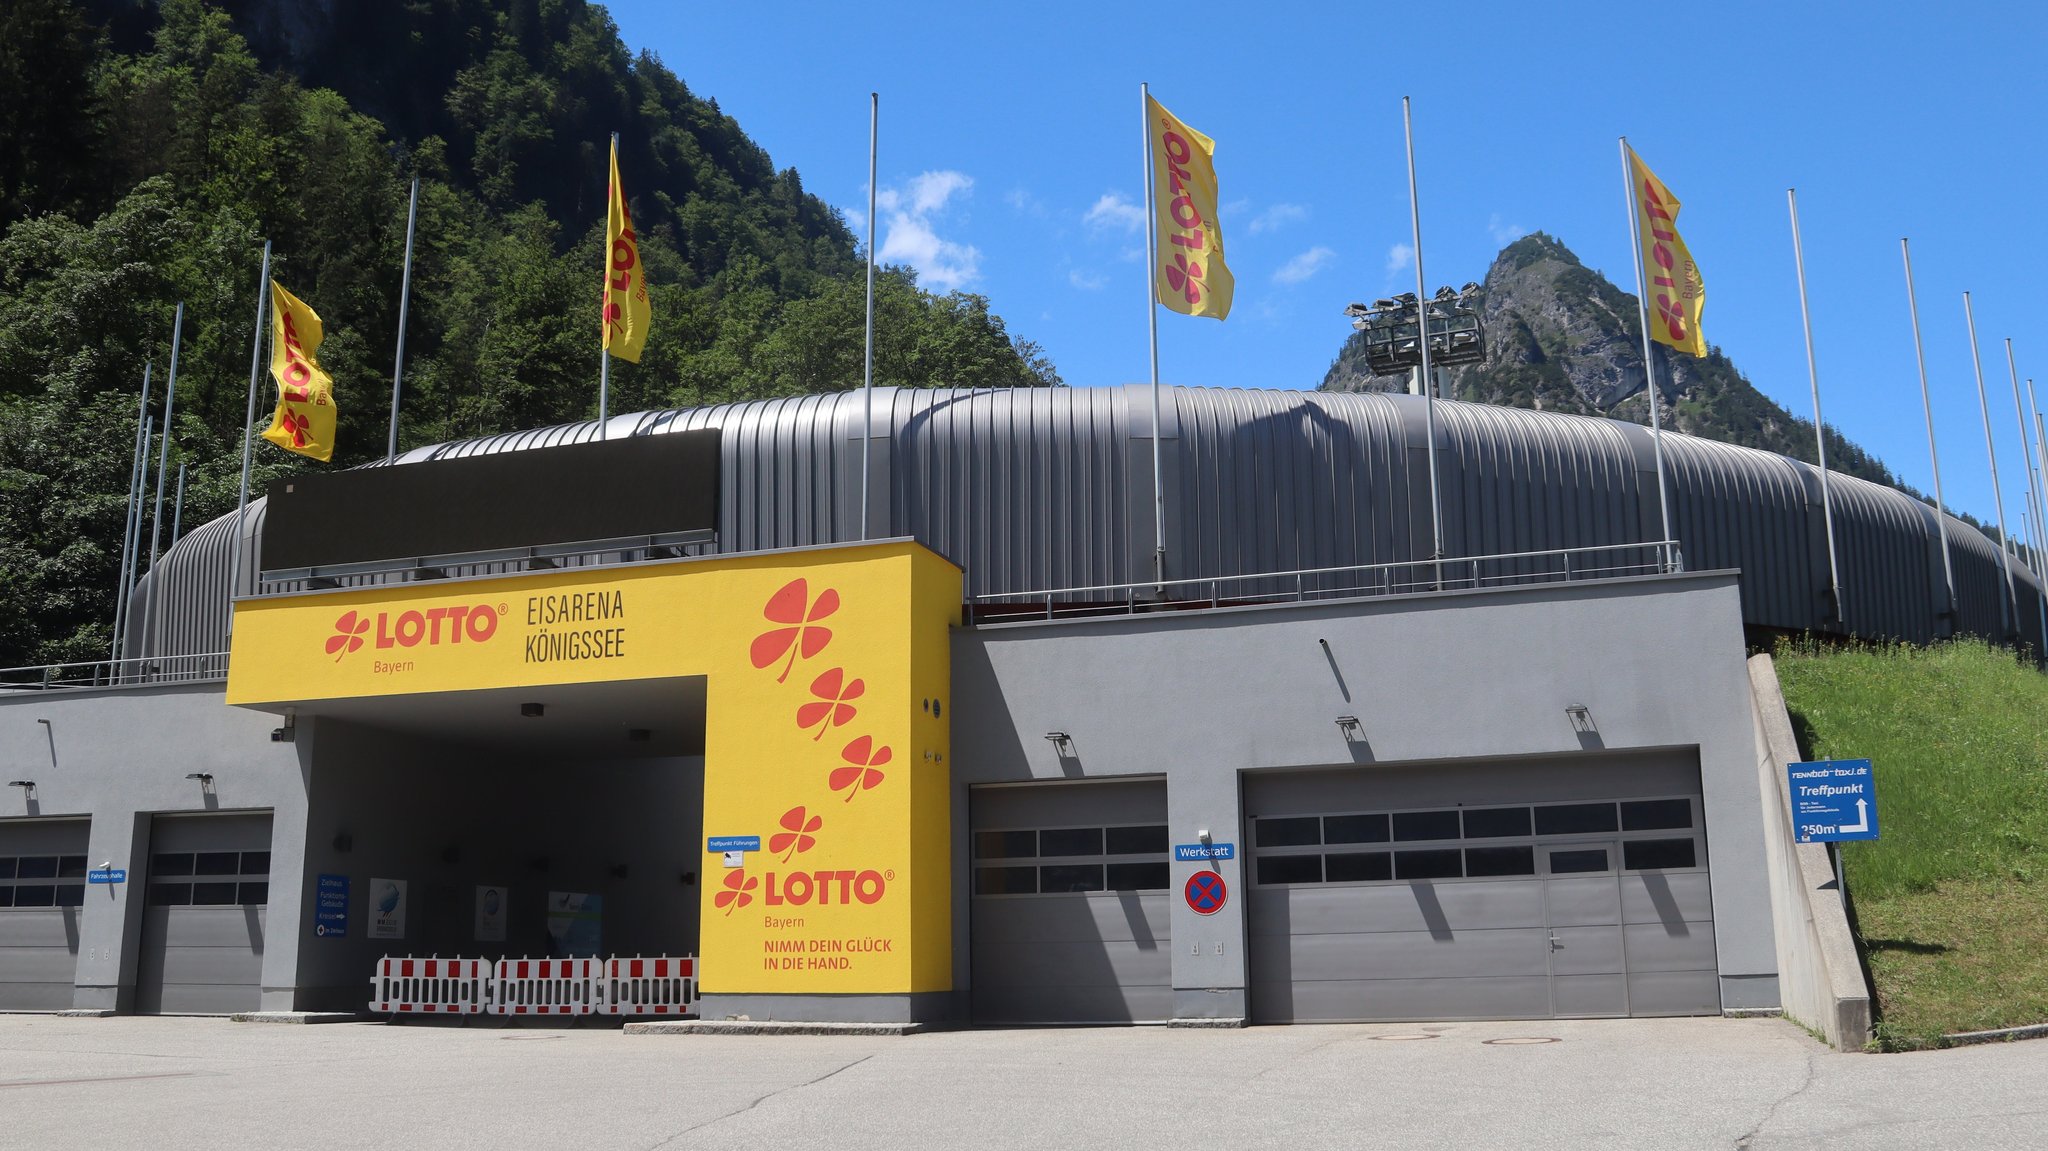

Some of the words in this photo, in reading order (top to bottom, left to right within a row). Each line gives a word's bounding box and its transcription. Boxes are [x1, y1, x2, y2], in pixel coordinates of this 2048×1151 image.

[1682, 259, 1694, 300] Bayern
[527, 590, 624, 626] EISARENA
[525, 628, 625, 663] KÖNIGSSEE
[373, 660, 414, 676] Bayern
[1799, 783, 1863, 798] Treffpunkt
[1180, 846, 1229, 857] Werkstatt
[764, 916, 804, 930] Bayern
[764, 940, 805, 953] NIMM
[809, 940, 841, 952] DEIN
[846, 937, 892, 952] GLÜCK
[764, 958, 778, 970] IN
[782, 957, 804, 970] DIE
[808, 957, 852, 970] HAND.
